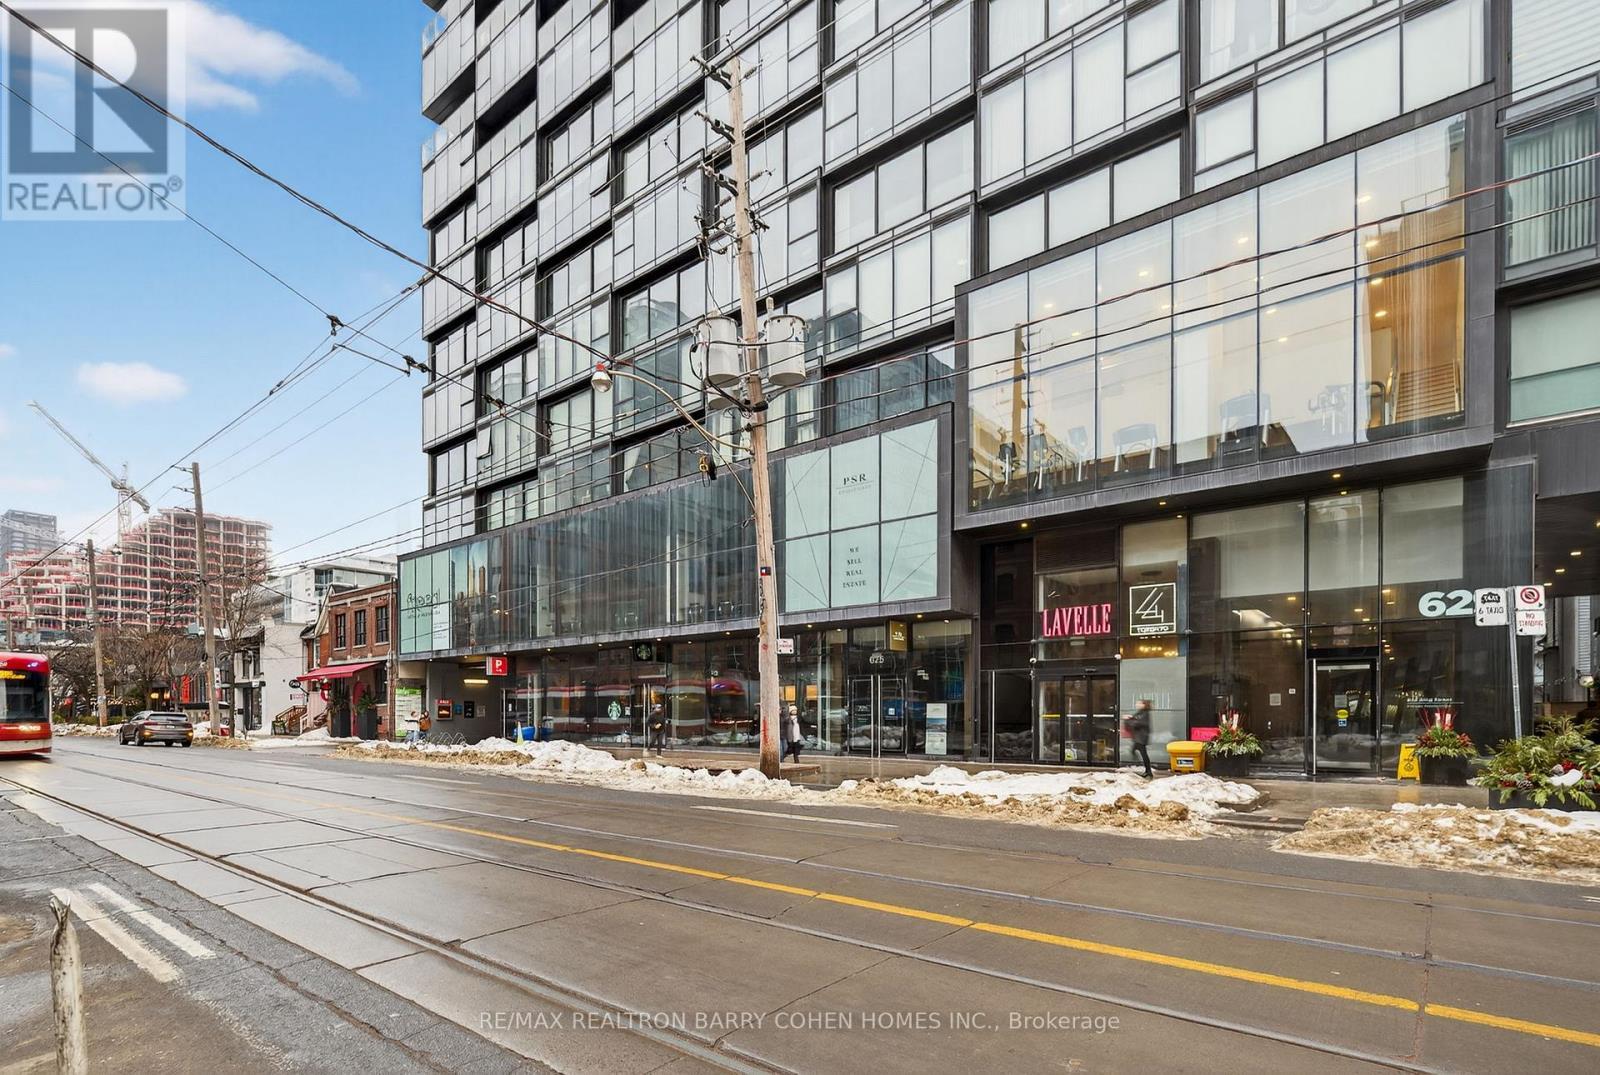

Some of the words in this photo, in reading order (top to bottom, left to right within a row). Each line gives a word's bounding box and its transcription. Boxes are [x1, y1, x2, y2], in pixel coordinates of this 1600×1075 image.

[843, 473, 867, 486] PSR
[1418, 589, 1476, 617] 62
[1042, 603, 1111, 637] LAVELLE
[495, 659, 503, 669] P
